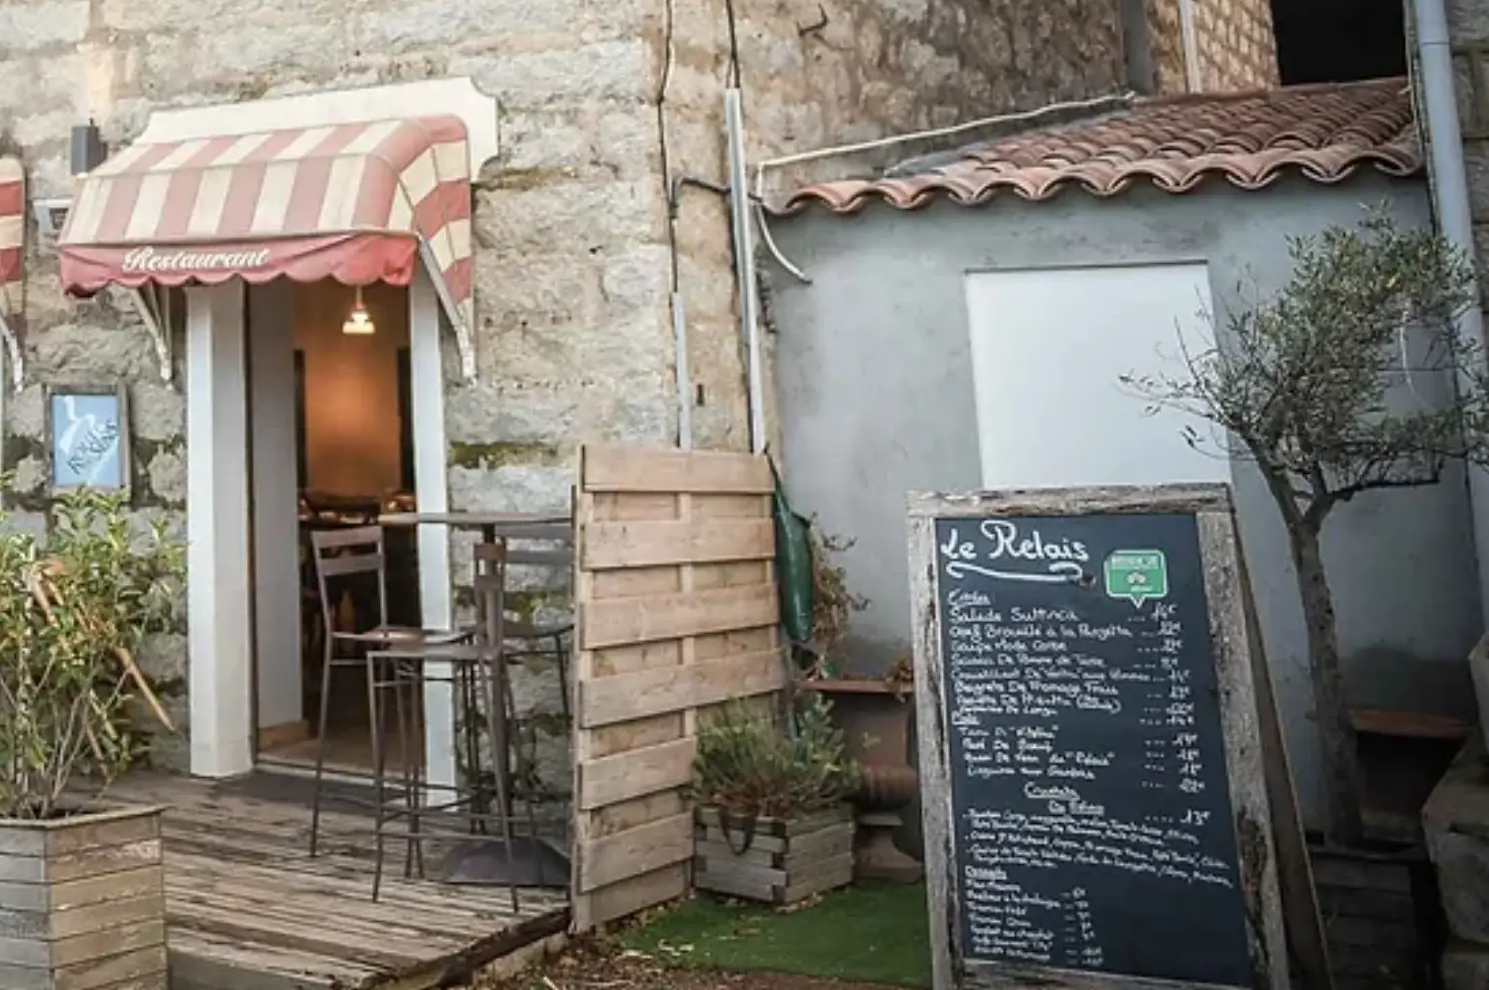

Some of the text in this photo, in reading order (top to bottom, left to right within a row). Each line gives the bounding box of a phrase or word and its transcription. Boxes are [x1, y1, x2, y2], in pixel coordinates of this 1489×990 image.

[121, 245, 270, 273] Restaurant
[940, 519, 1089, 561] Le Relais
